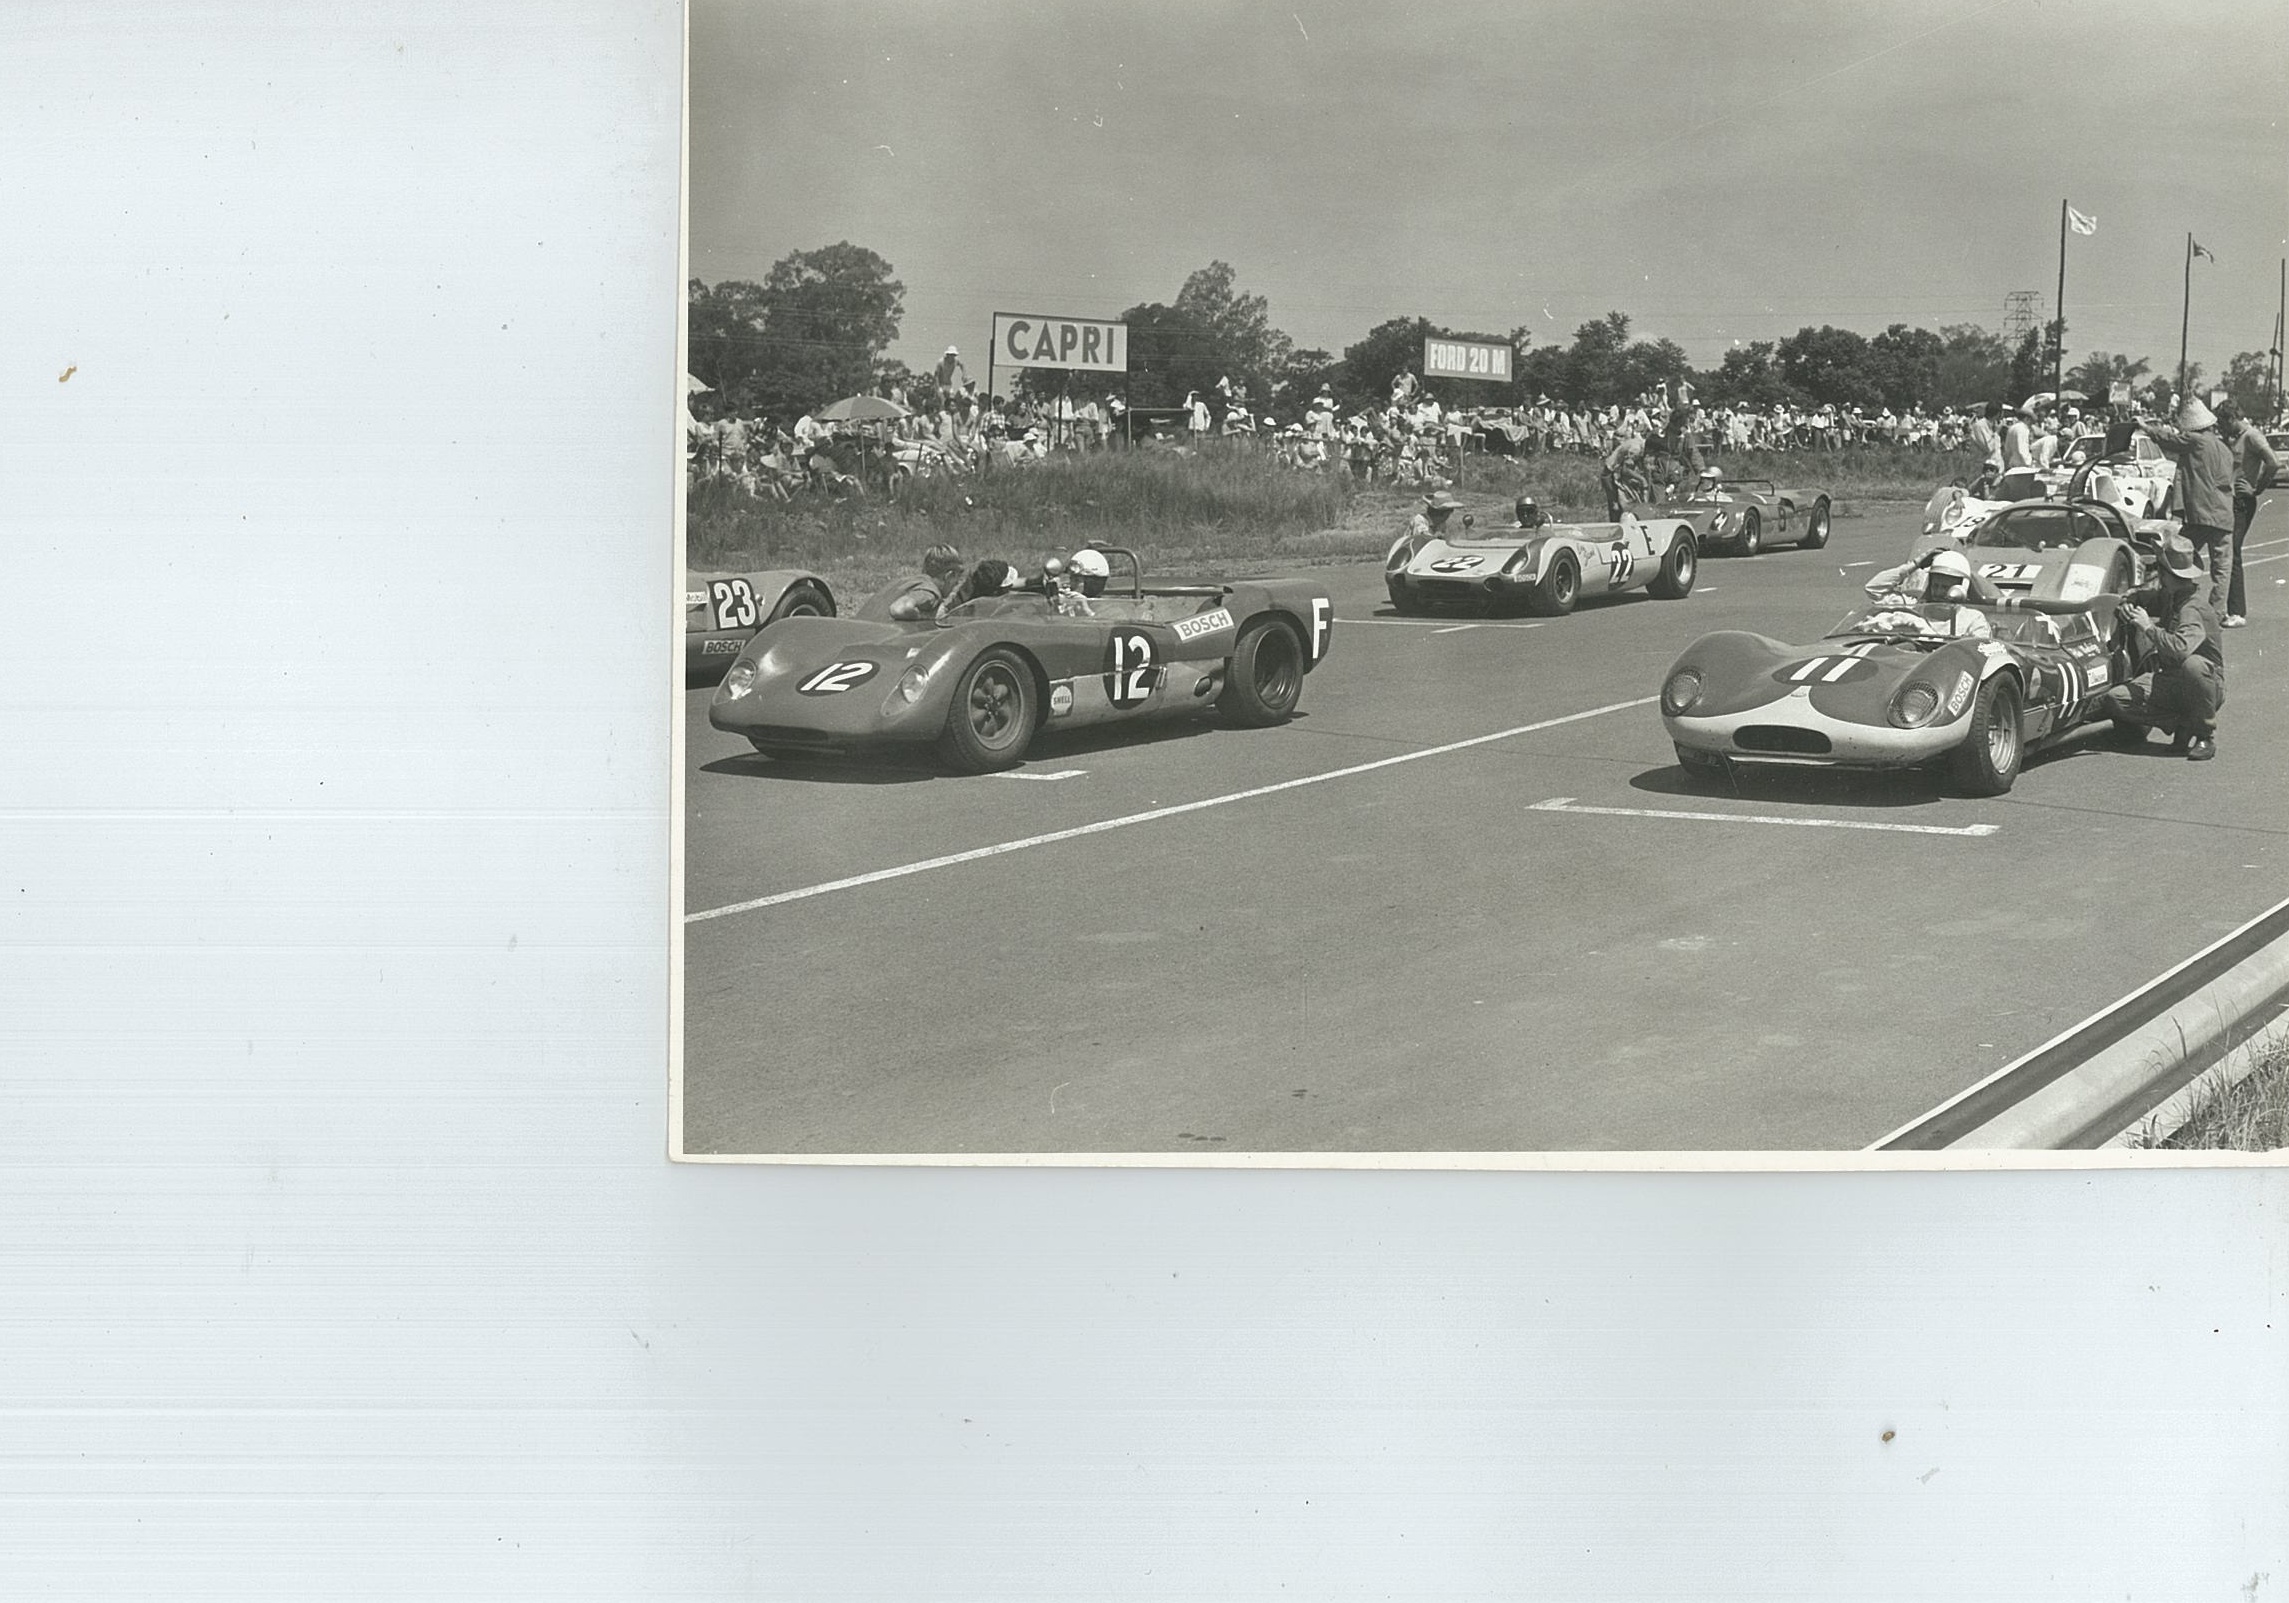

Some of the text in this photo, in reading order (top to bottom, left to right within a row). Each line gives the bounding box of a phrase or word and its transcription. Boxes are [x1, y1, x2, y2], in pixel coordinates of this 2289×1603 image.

[1007, 320, 1114, 364] CAPRI
[1430, 343, 1505, 375] FORD 20 M
[1640, 525, 1656, 556] E
[1610, 549, 1633, 584] 22
[1985, 564, 2028, 579] 21
[713, 580, 756, 629] 23
[1179, 612, 1230, 638] BOSCH
[1312, 598, 1329, 659] F
[706, 641, 743, 653] BOSCH
[800, 662, 873, 692] 12
[1114, 635, 1151, 701] 12
[1790, 657, 1862, 682] 11
[1053, 695, 1071, 705] SHELL
[1950, 674, 1972, 712] BOSCH
[2057, 662, 2079, 719] 11
